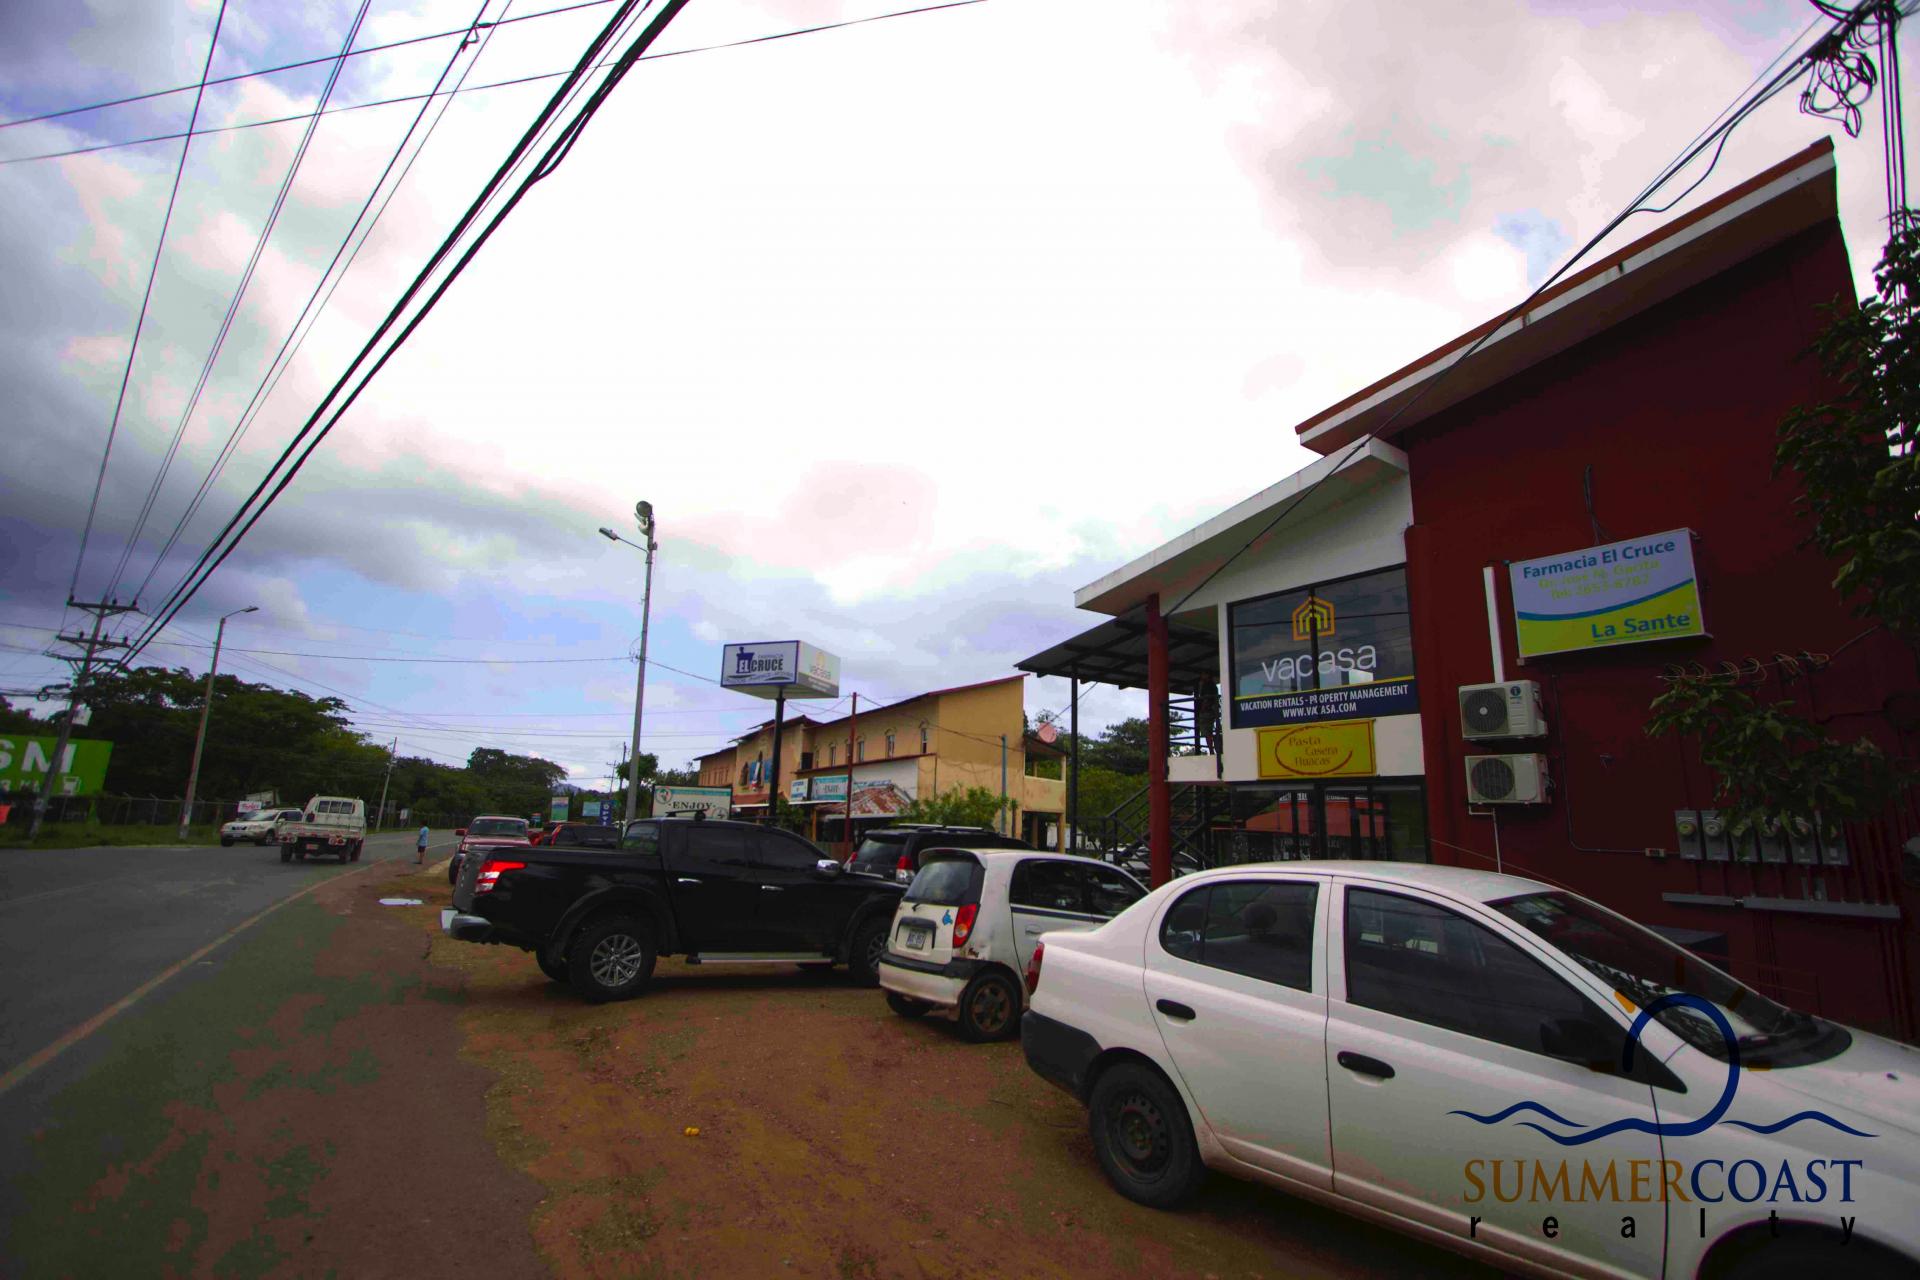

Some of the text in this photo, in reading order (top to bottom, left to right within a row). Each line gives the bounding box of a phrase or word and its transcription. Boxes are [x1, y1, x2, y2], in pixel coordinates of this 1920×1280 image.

[1523, 540, 1676, 579] Farmacia El Cruce
[1591, 623, 1616, 638] La
[1623, 613, 1691, 634] Sante
[739, 659, 784, 673] EL CRUCE
[1261, 645, 1377, 682] vacasa
[1240, 702, 1273, 712] VACATION
[1273, 698, 1304, 708] RENTALS
[1350, 684, 1409, 700] MANAGEMENT
[1288, 737, 1321, 746] Pasta
[672, 801, 713, 809] ENJOY
